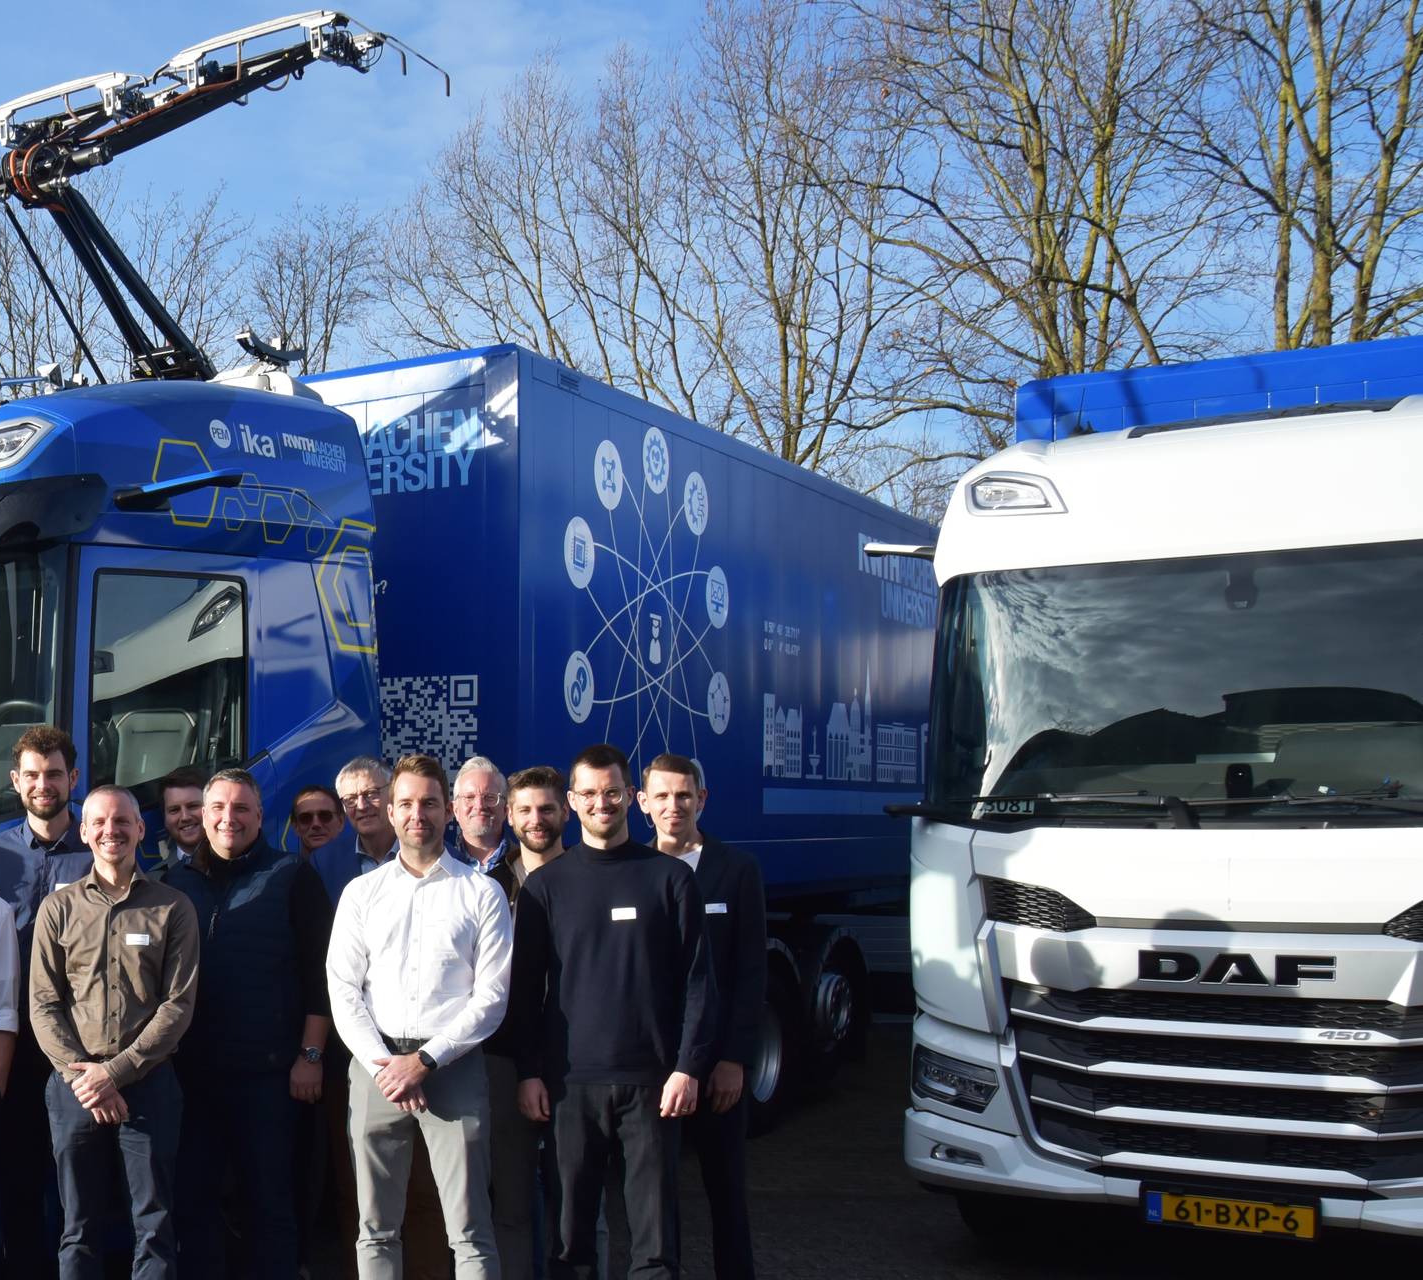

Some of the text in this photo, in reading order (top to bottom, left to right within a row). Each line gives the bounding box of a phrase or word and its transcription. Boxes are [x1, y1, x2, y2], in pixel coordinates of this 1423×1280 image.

[212, 426, 229, 441] PEM
[240, 424, 277, 459] ika
[361, 406, 479, 458] ACHEN
[302, 452, 347, 474] UNIVERSITY
[1138, 949, 1337, 987] DAF
[1318, 1030, 1372, 1041] 450
[1148, 1209, 1160, 1217] NL
[1174, 1200, 1300, 1232] 61-BXP-6
